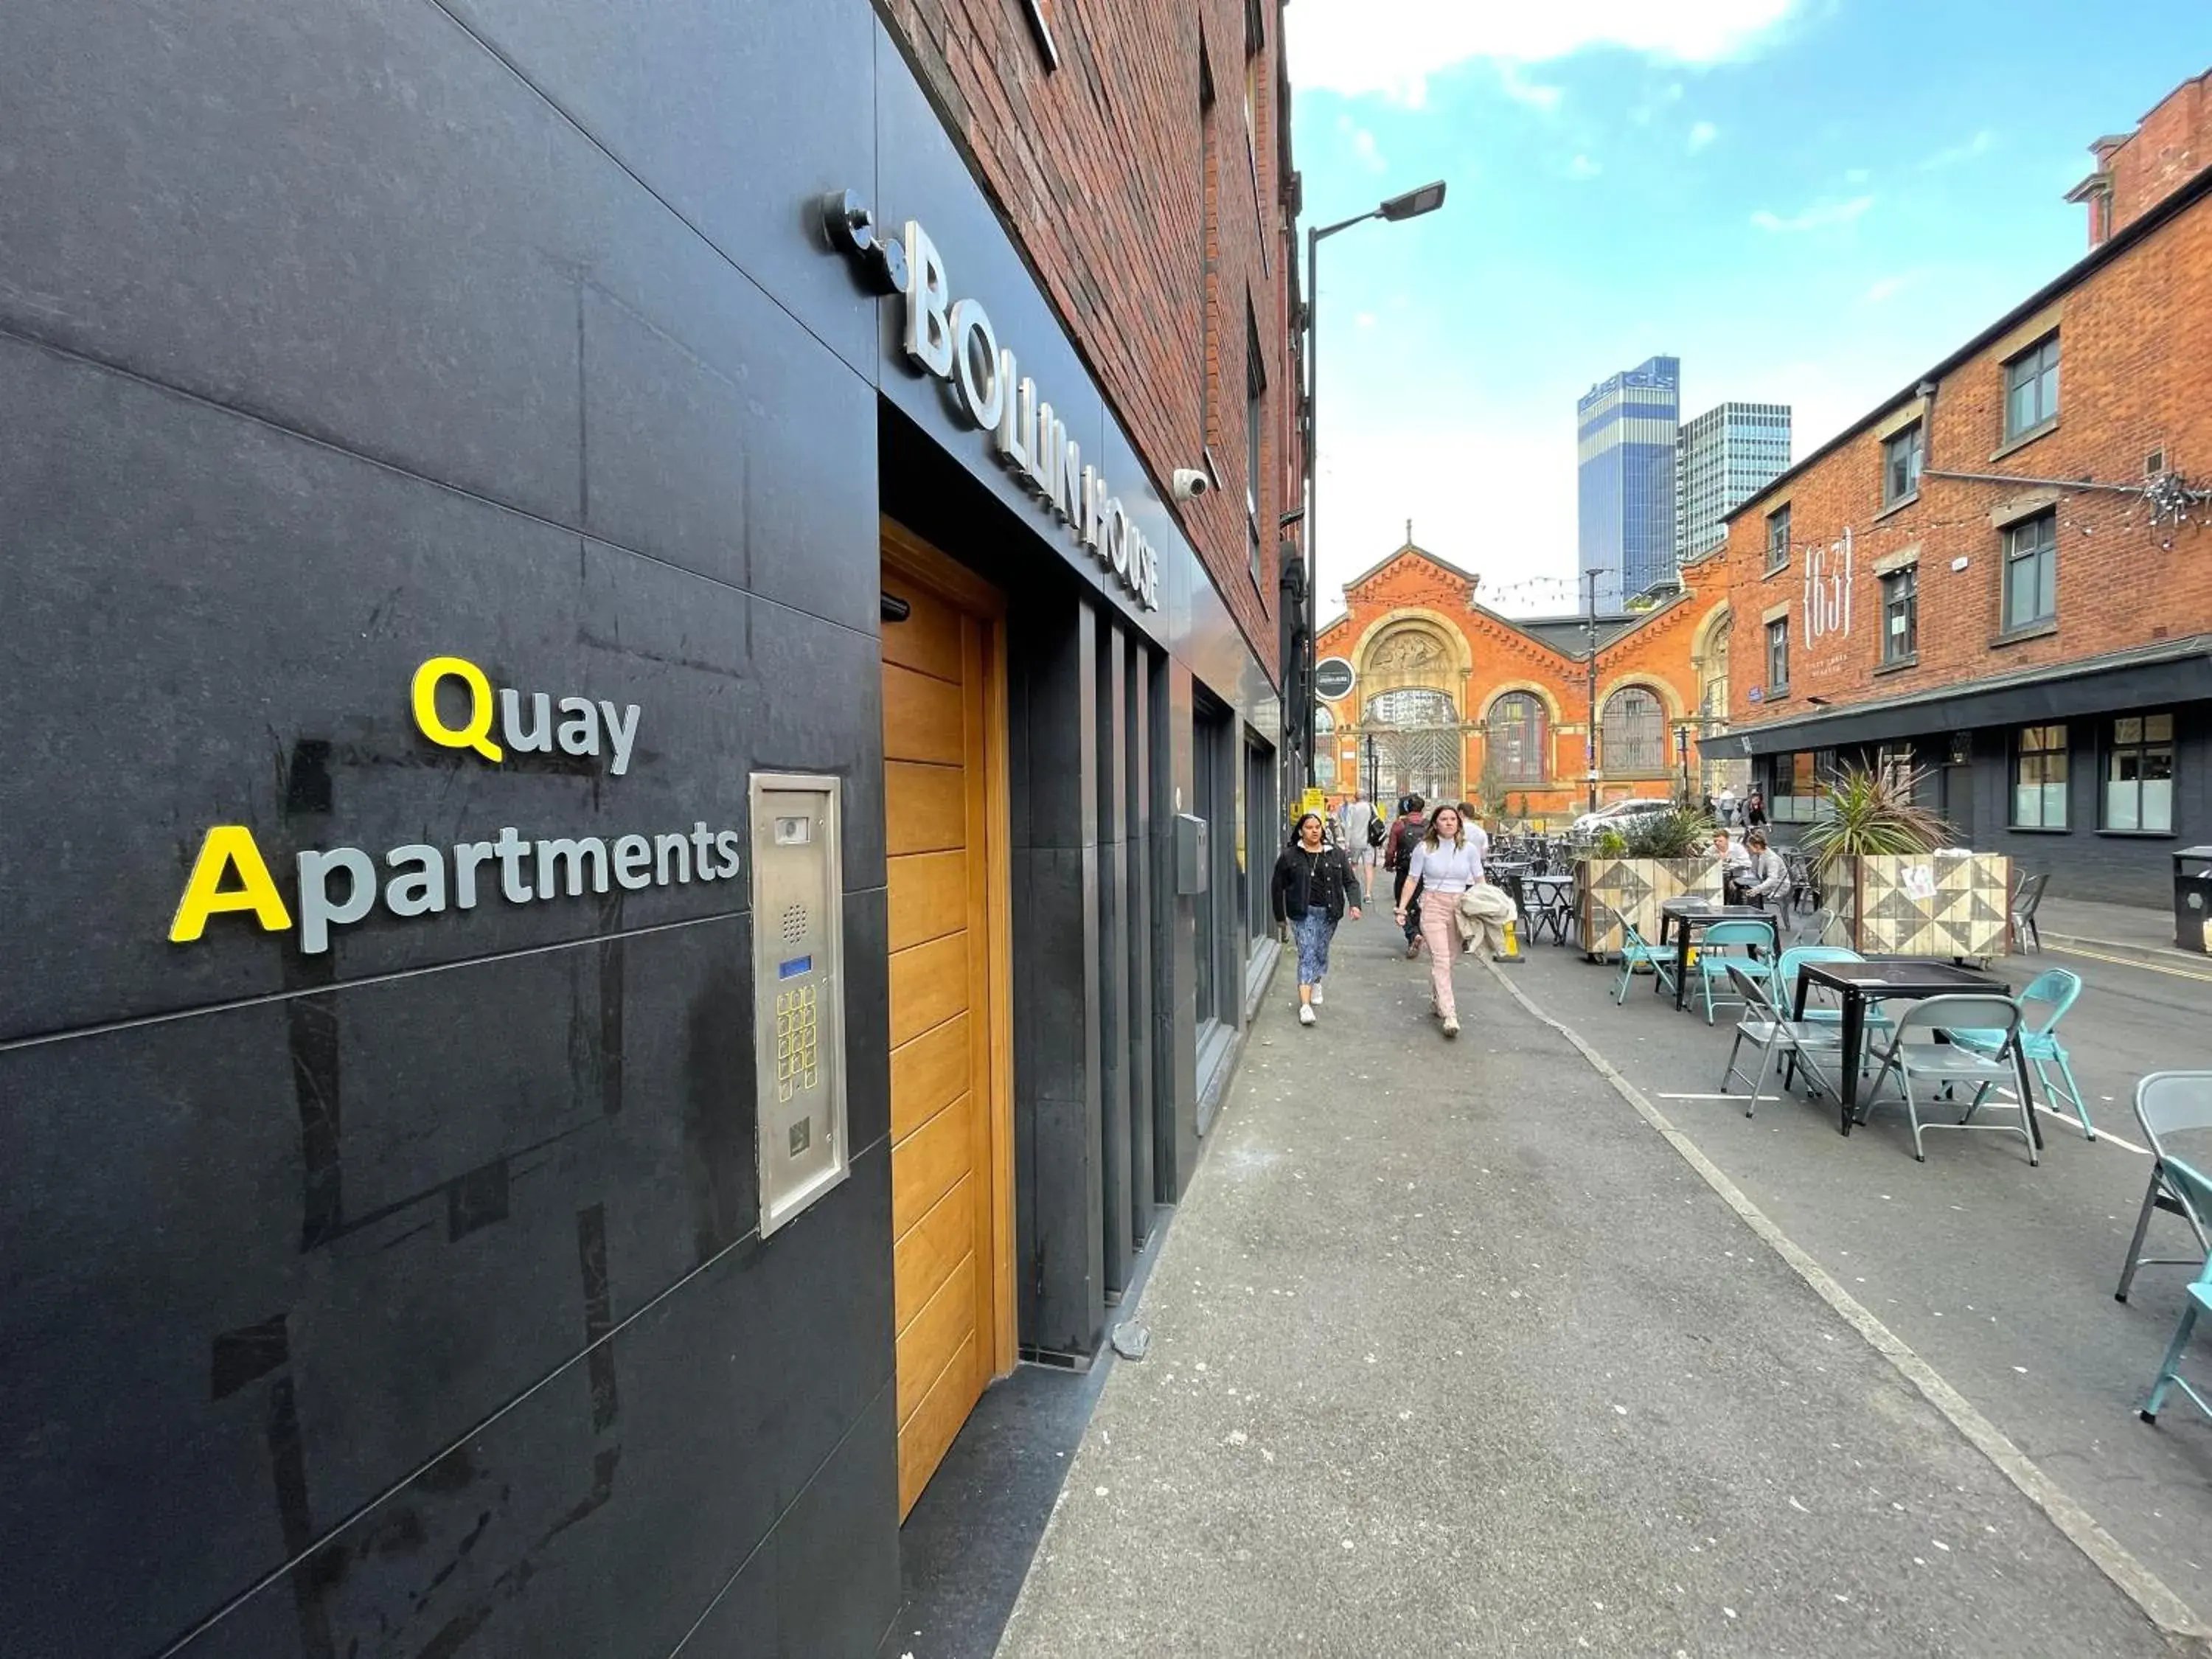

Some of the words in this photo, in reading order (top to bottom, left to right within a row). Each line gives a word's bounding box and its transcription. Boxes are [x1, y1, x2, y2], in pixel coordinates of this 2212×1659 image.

[905, 220, 1080, 529] BOLLIN
[410, 656, 641, 776] Quay
[169, 821, 740, 953] Apartments
